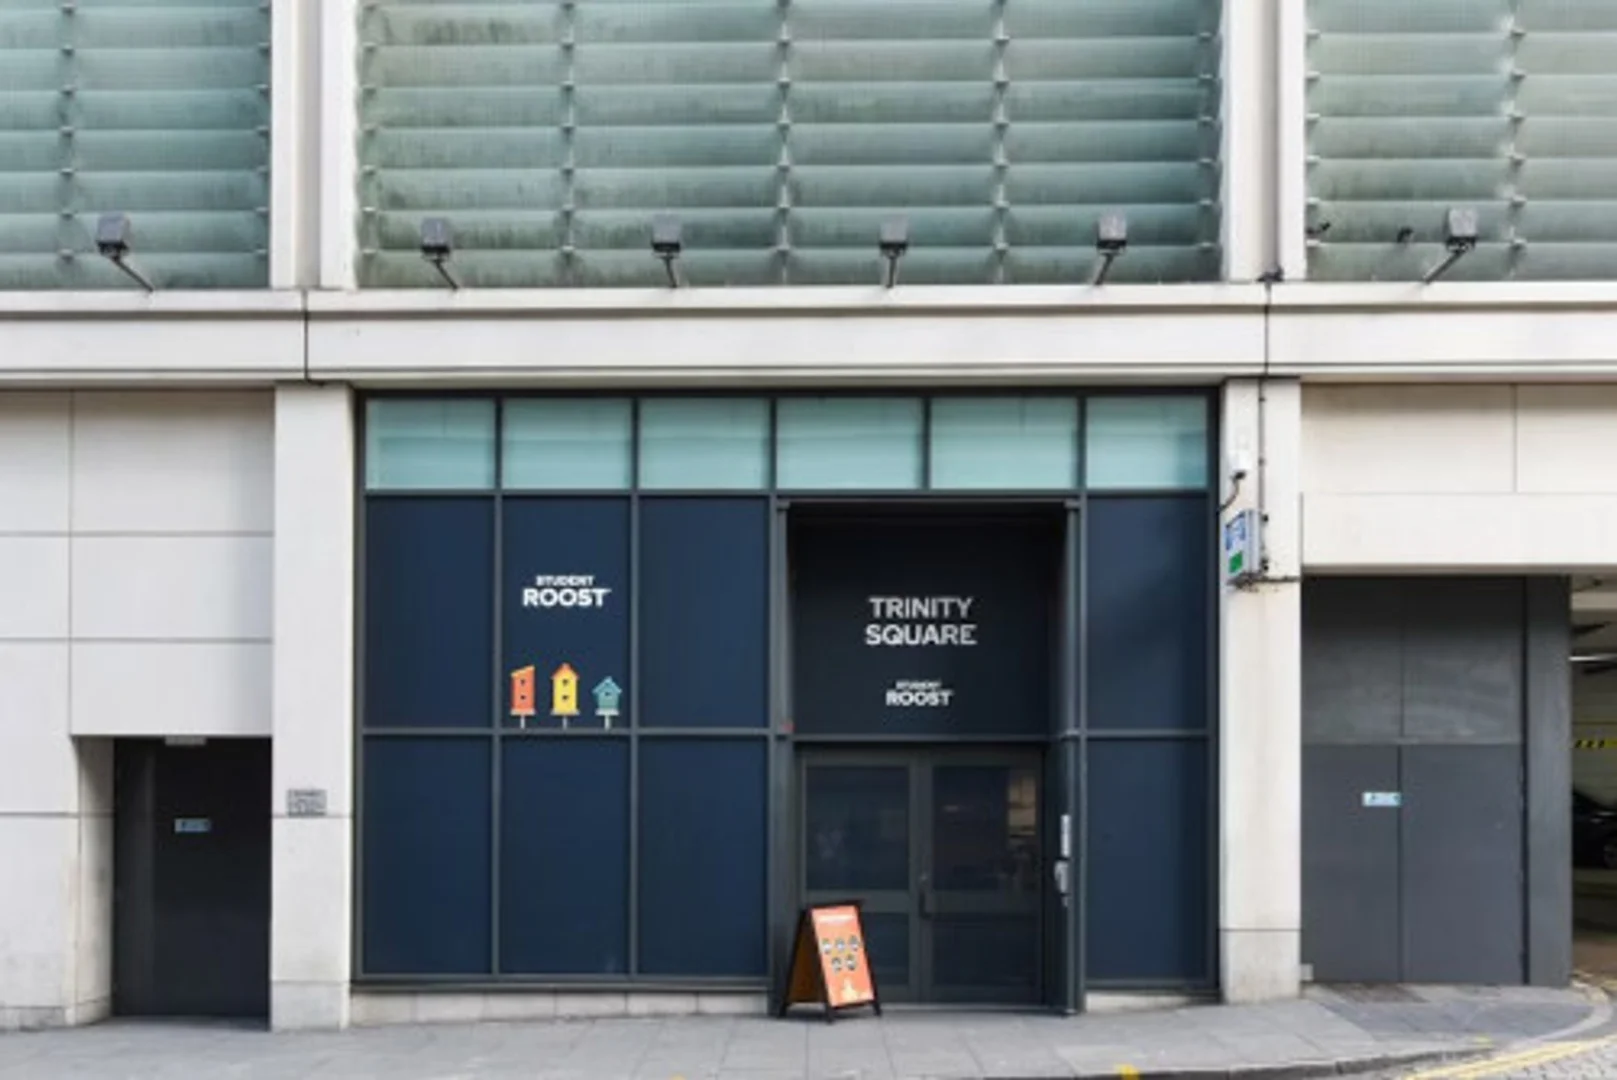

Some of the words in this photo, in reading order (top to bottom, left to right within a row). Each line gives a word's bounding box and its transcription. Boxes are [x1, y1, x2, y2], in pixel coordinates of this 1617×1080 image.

[522, 588, 612, 607] ROOST
[869, 597, 973, 618] TRINITY
[865, 624, 977, 646] SQUARE
[885, 690, 952, 706] ROOST
